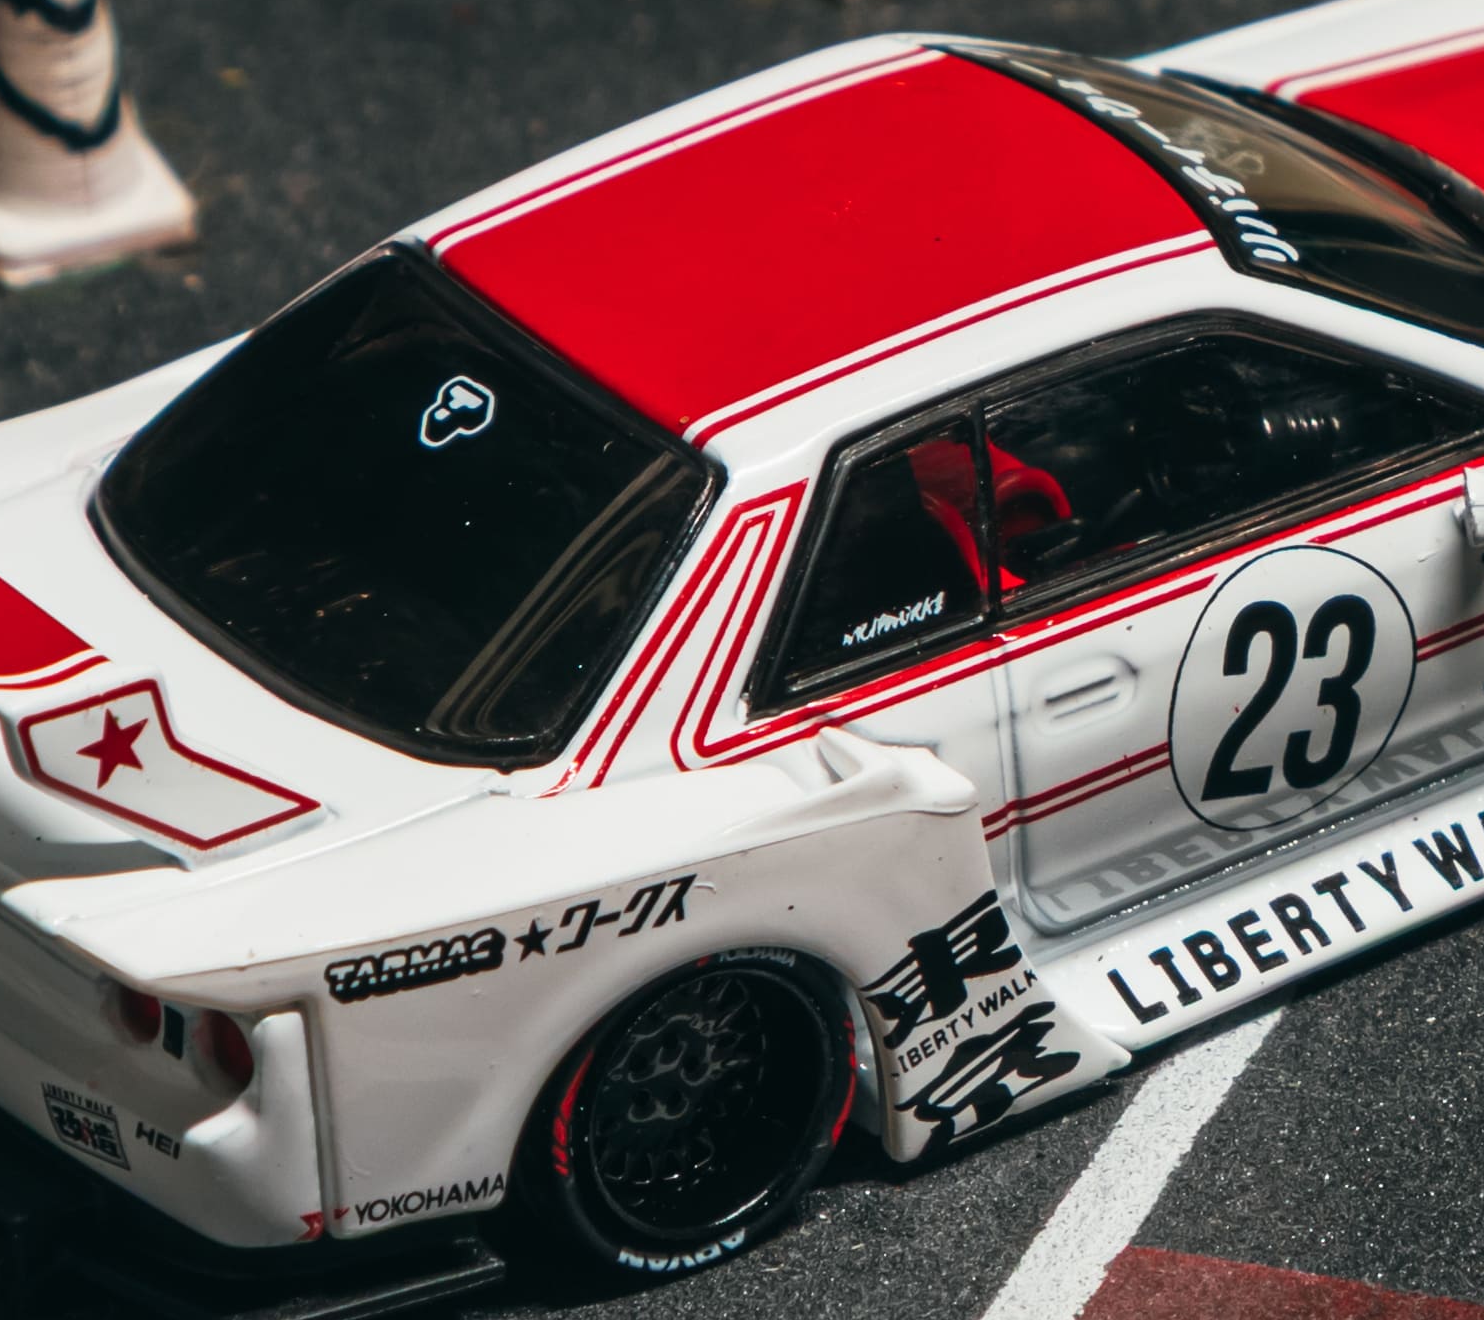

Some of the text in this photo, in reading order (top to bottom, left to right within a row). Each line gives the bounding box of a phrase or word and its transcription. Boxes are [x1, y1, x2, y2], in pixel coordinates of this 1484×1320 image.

[1201, 594, 1376, 801] 23
[327, 873, 698, 998] TARMAC ワークス
[1106, 850, 1413, 1024] LIBERTY
[977, 968, 1039, 1017] WALK
[135, 1121, 181, 1160] HEI
[354, 1172, 505, 1226] YOKOHAMA
[618, 1227, 746, 1271] ADVAN
